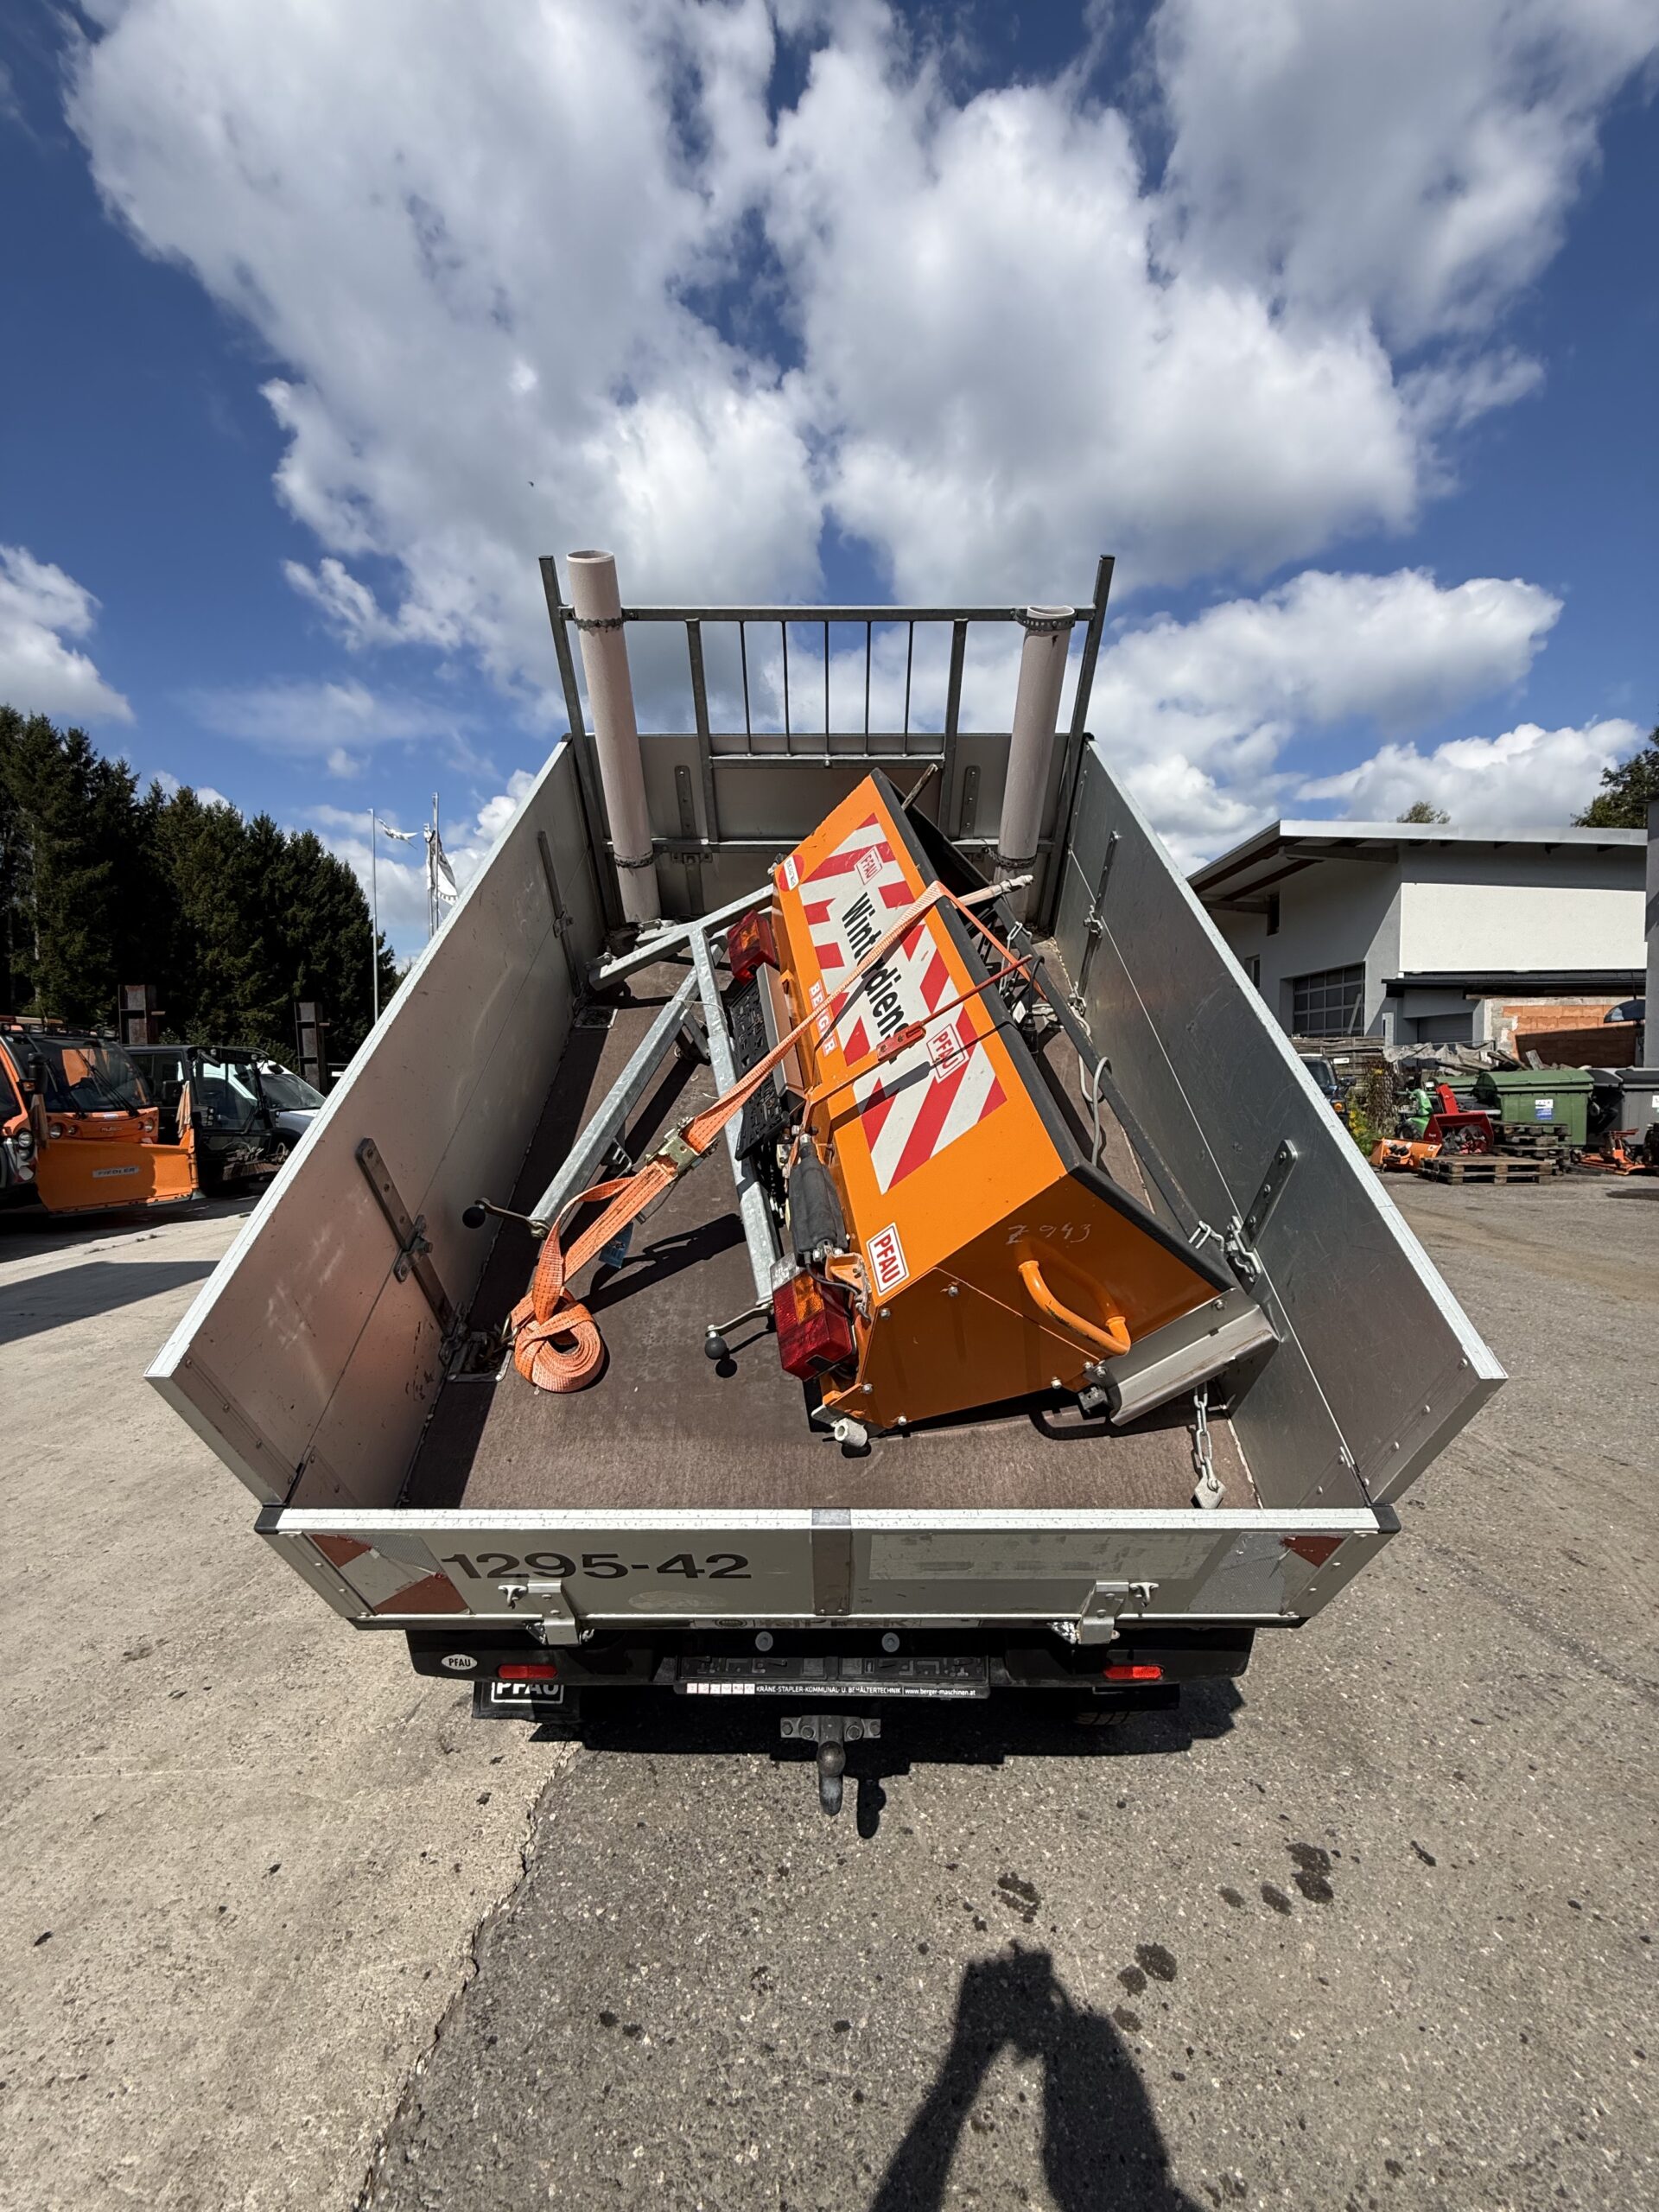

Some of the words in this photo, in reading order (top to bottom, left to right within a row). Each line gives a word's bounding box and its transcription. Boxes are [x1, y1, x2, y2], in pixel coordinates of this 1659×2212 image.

[842, 892, 910, 1065] Wintrdien
[810, 980, 836, 1056] BEGR
[874, 1233, 900, 1284] PFAU
[442, 1552, 752, 1580] 1295-42
[448, 1658, 471, 1667] PFAU
[905, 1688, 976, 1696] www.berger-maschinen.at
